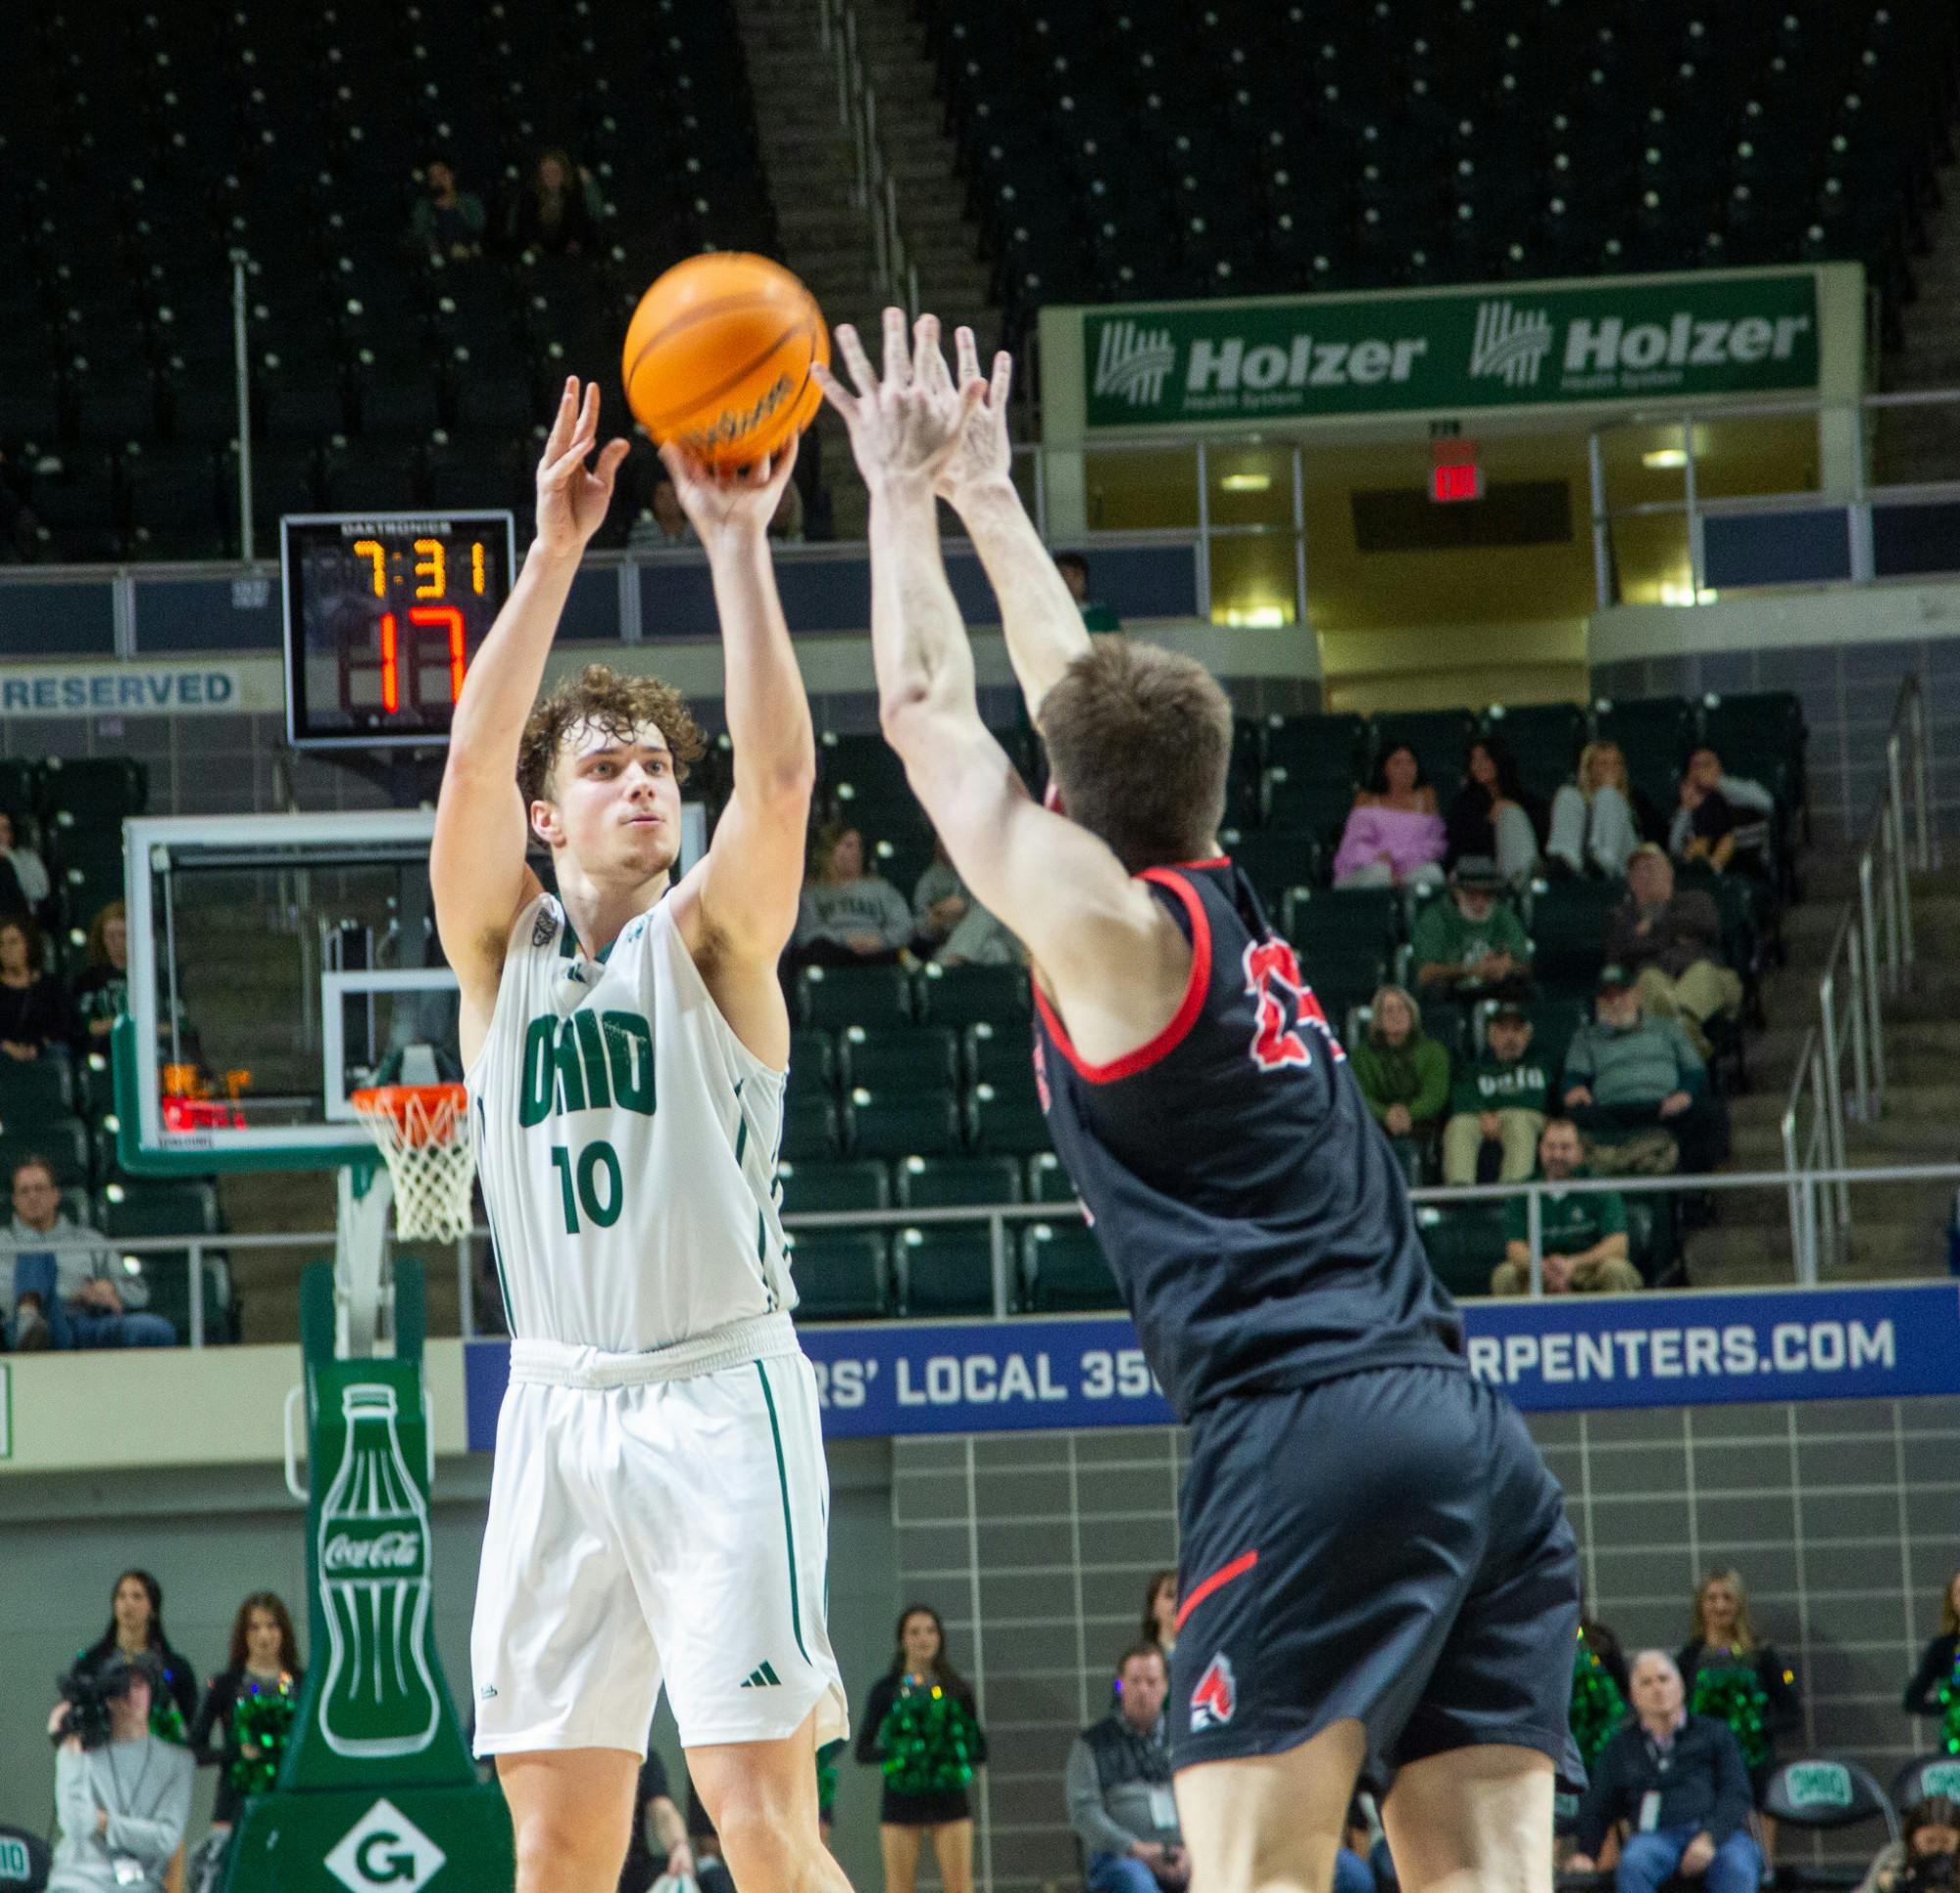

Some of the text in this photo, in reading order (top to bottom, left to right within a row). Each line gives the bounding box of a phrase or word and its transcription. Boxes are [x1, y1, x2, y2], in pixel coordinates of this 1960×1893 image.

[1187, 334, 1428, 391] Holzer
[1565, 313, 1809, 370] Holzer
[354, 540, 485, 599] 7:31
[380, 606, 466, 714] 17
[3, 673, 231, 708] RESERVED
[518, 1008, 657, 1128] OHIO
[551, 1140, 623, 1235] 10
[896, 1353, 1067, 1405] LOCAL
[1081, 1350, 1164, 1398] 35
